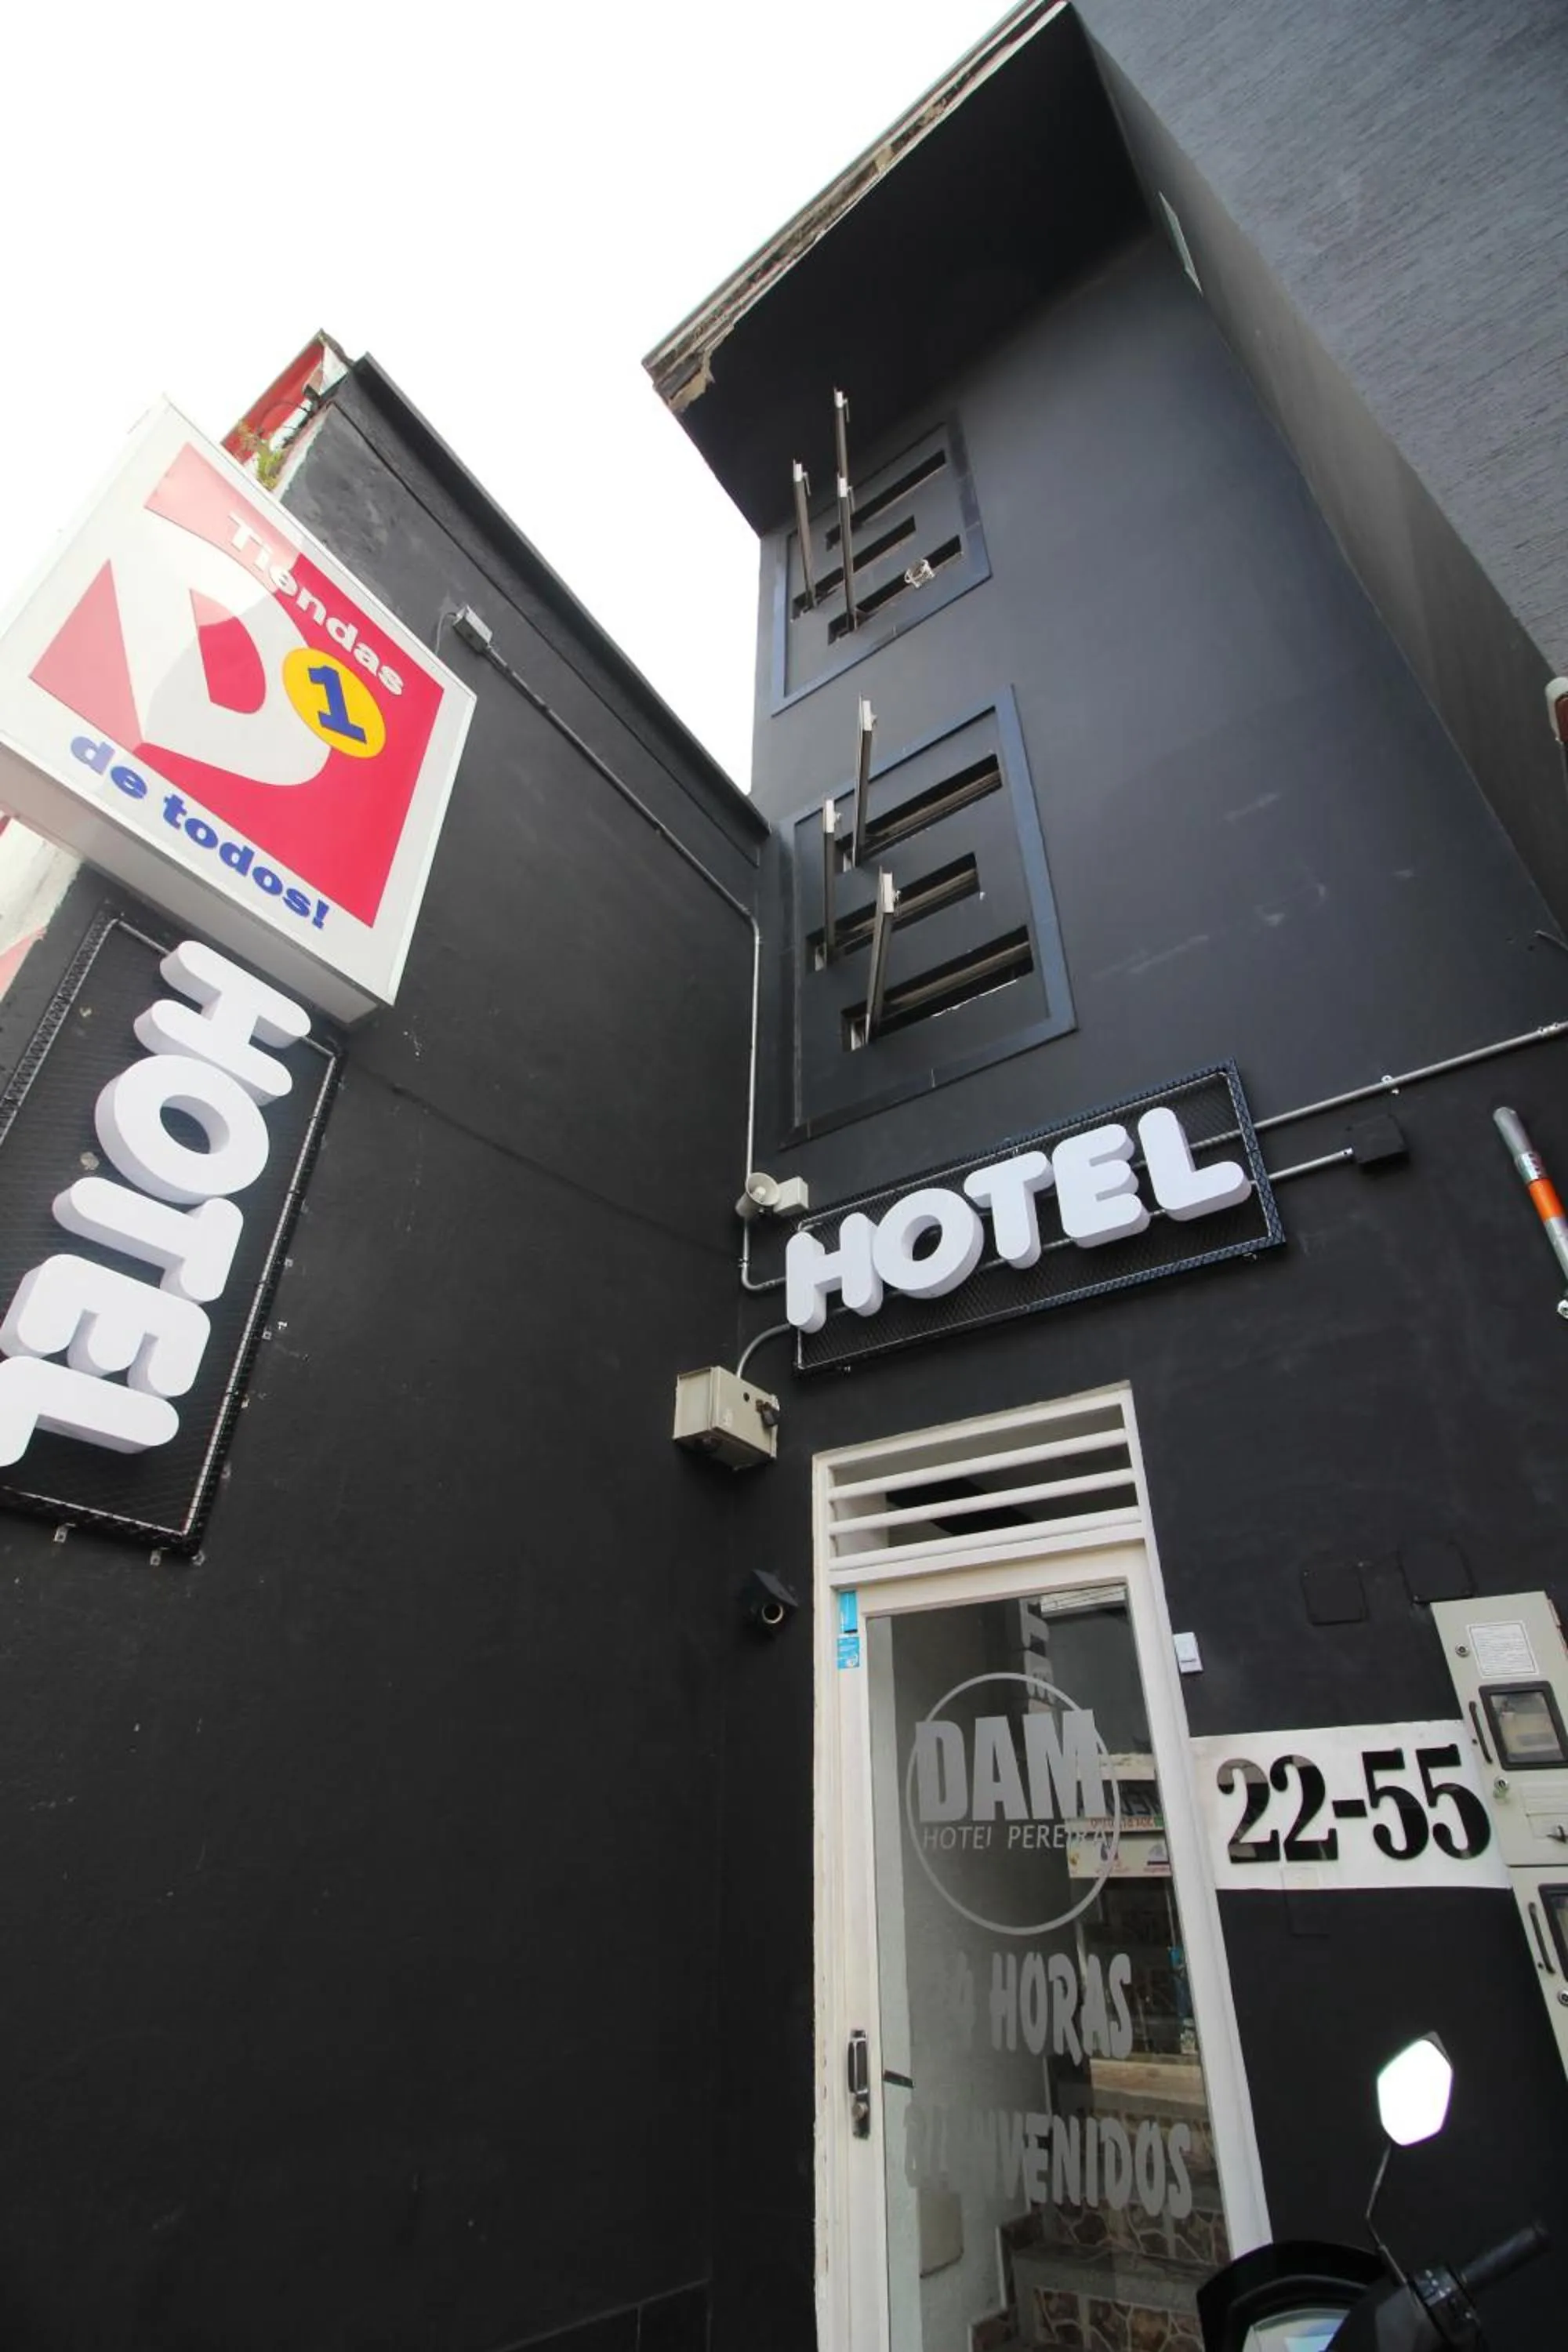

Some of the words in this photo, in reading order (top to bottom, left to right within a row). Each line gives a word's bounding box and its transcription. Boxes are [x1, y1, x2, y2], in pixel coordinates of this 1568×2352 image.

[228, 513, 403, 696] Tiendas
[71, 736, 147, 800] de
[163, 793, 329, 930] todos!
[0, 940, 312, 1466] HOTEL
[786, 1106, 1251, 1334] HOTEL
[916, 1708, 1108, 1822] DAM
[1217, 1744, 1490, 1864] 22-55
[989, 1951, 1134, 2067] HORAS
